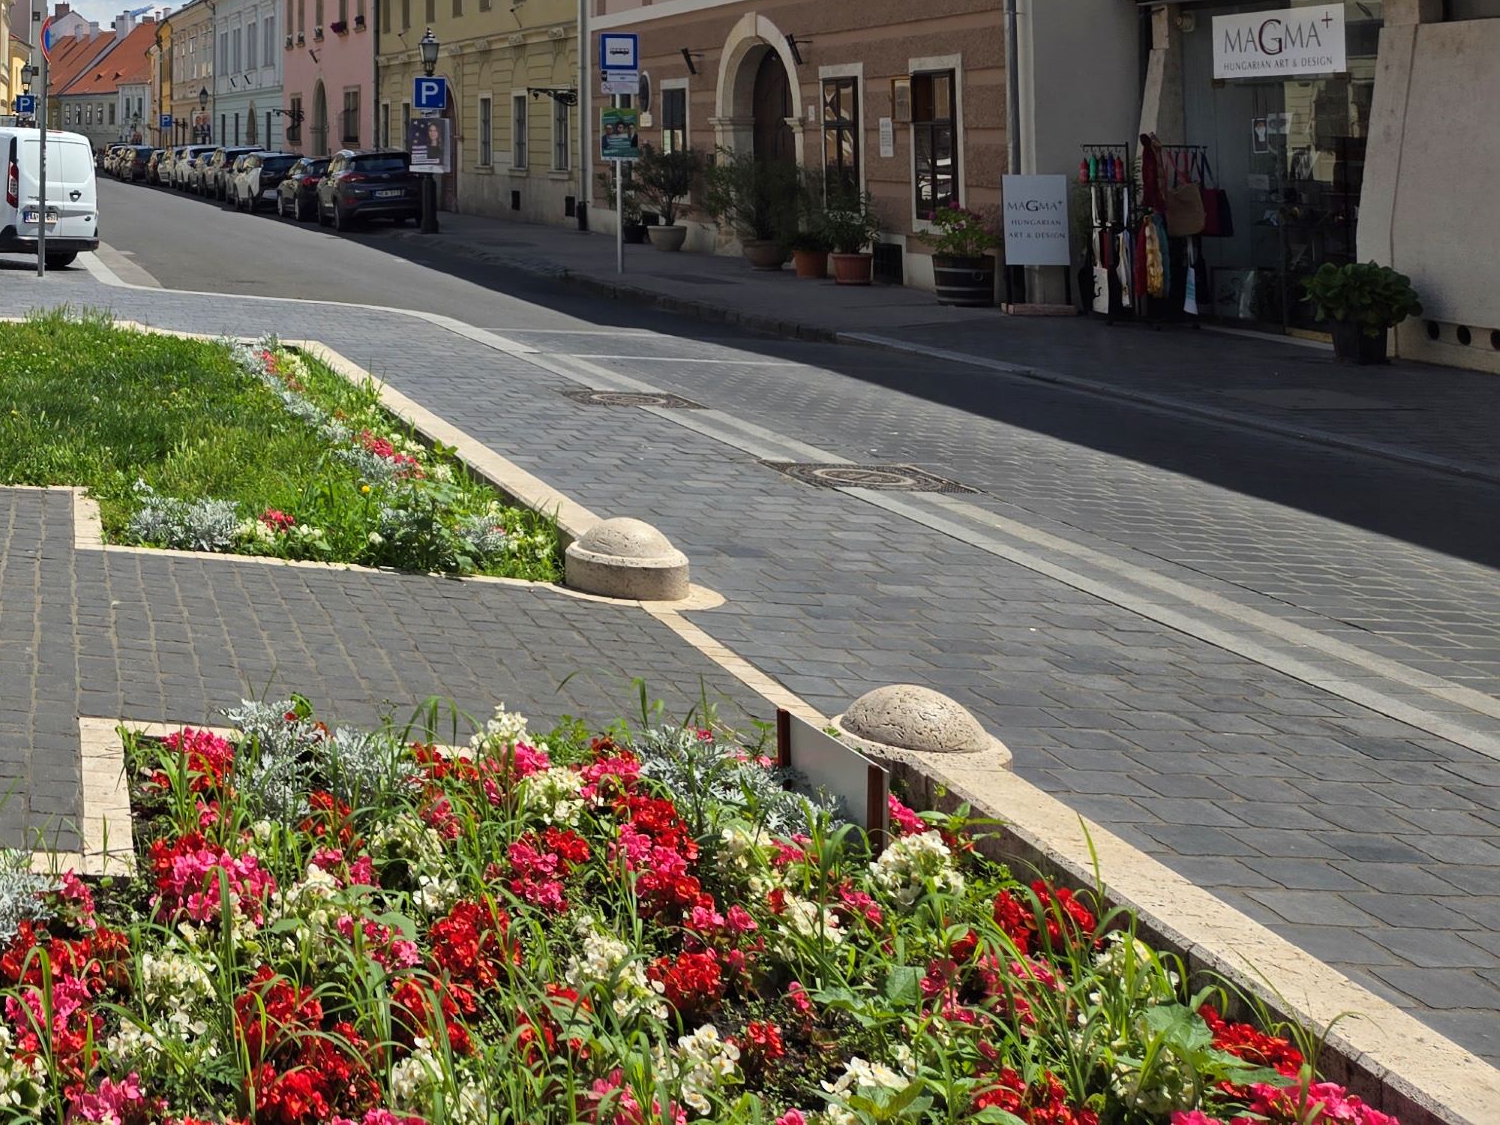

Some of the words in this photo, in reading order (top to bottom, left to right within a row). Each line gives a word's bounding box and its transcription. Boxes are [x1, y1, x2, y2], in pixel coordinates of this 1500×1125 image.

[1223, 60, 1271, 71] HUNGARIAN
[1274, 58, 1289, 68] ART
[1301, 56, 1333, 67] DESIGN
[421, 81, 439, 105] P
[19, 97, 31, 112] P
[161, 116, 170, 127] P
